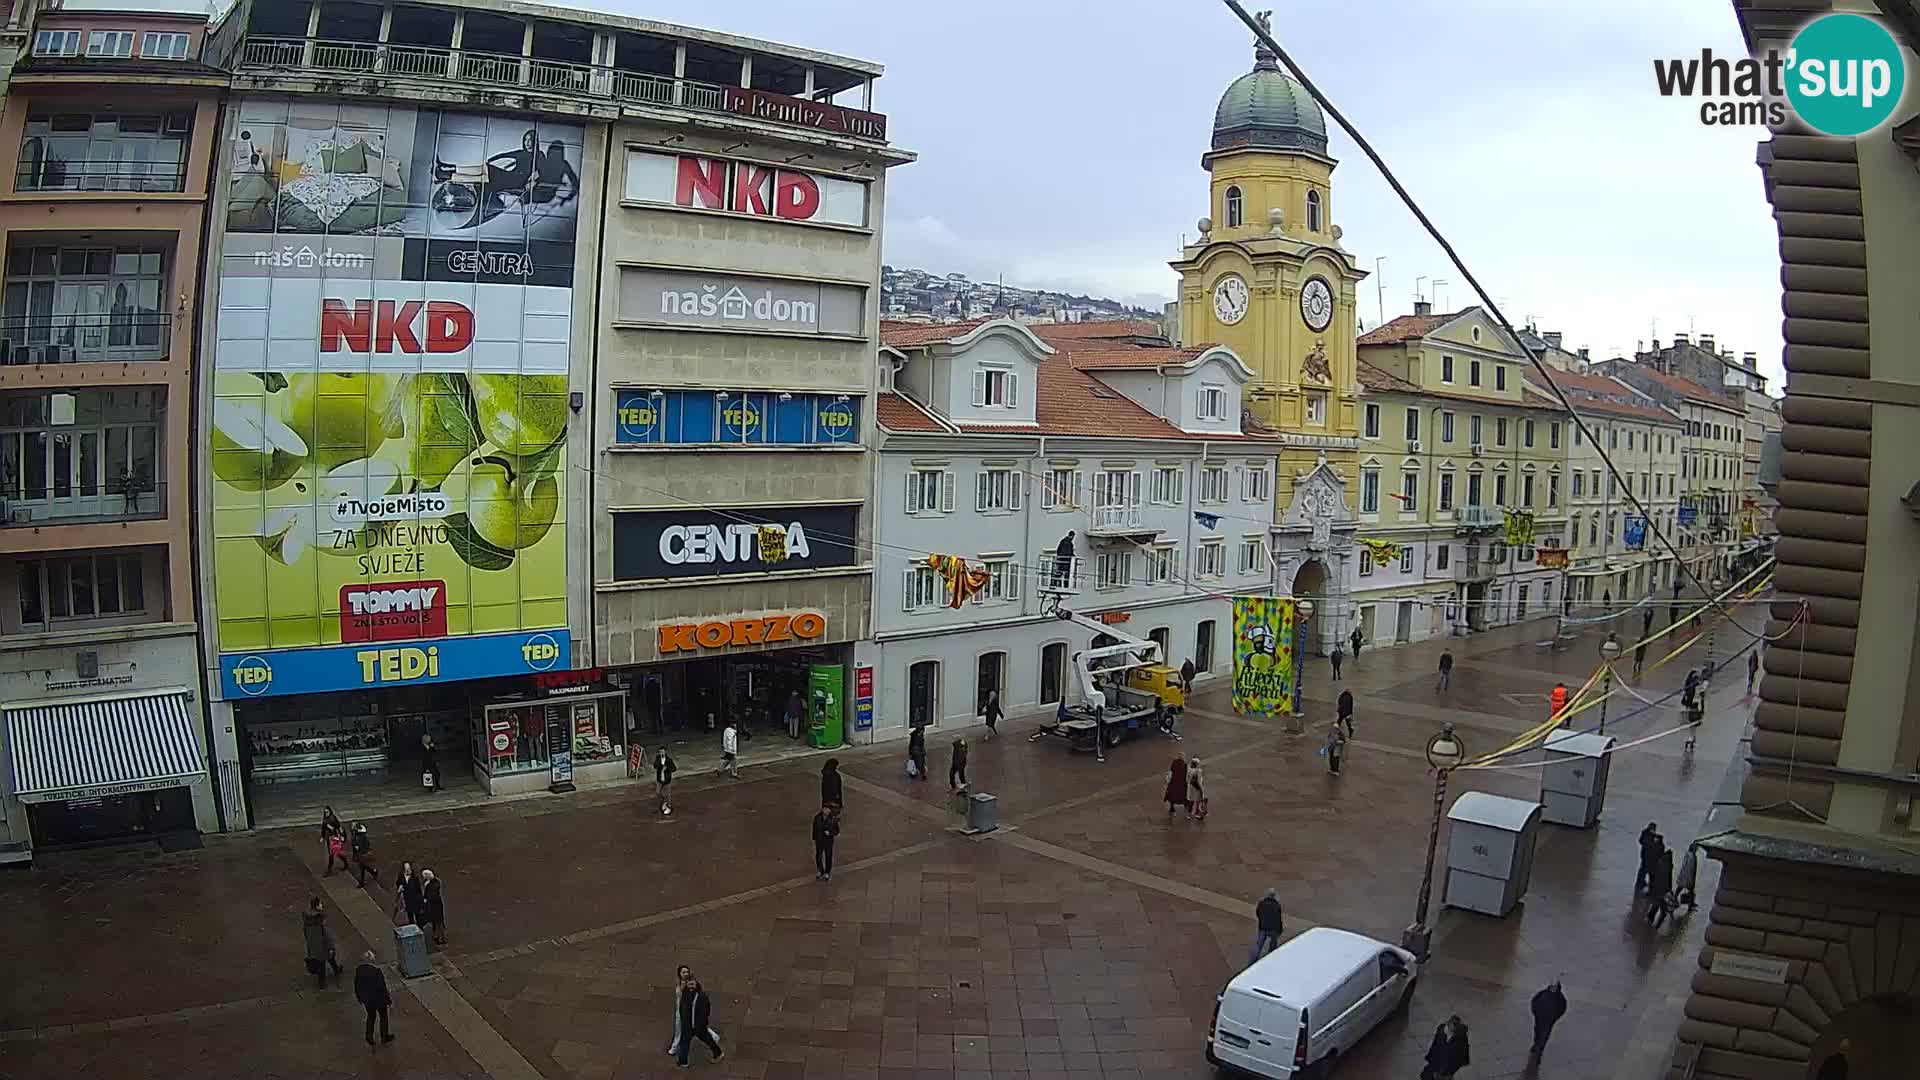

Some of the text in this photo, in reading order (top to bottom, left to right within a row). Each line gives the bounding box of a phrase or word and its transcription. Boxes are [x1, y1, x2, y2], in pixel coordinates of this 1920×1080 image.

[723, 89, 745, 111] Le
[675, 154, 820, 221] NKD
[254, 246, 364, 269] naš dom
[447, 250, 535, 276] CENTRA
[661, 284, 817, 324] naš dom
[320, 298, 476, 354] NKD
[618, 408, 658, 426] TEDi
[723, 409, 760, 427] TEDi
[820, 412, 853, 428] TEDi
[337, 498, 446, 518] #TvojeMisto
[332, 524, 450, 550] ZA DNEVNO
[358, 548, 425, 576] SVJEŽE
[347, 586, 439, 616] TOMMY
[659, 613, 826, 654] KORZO
[357, 646, 440, 684] TEDi
[522, 643, 559, 661] TEDi
[232, 666, 272, 685] TEDi
